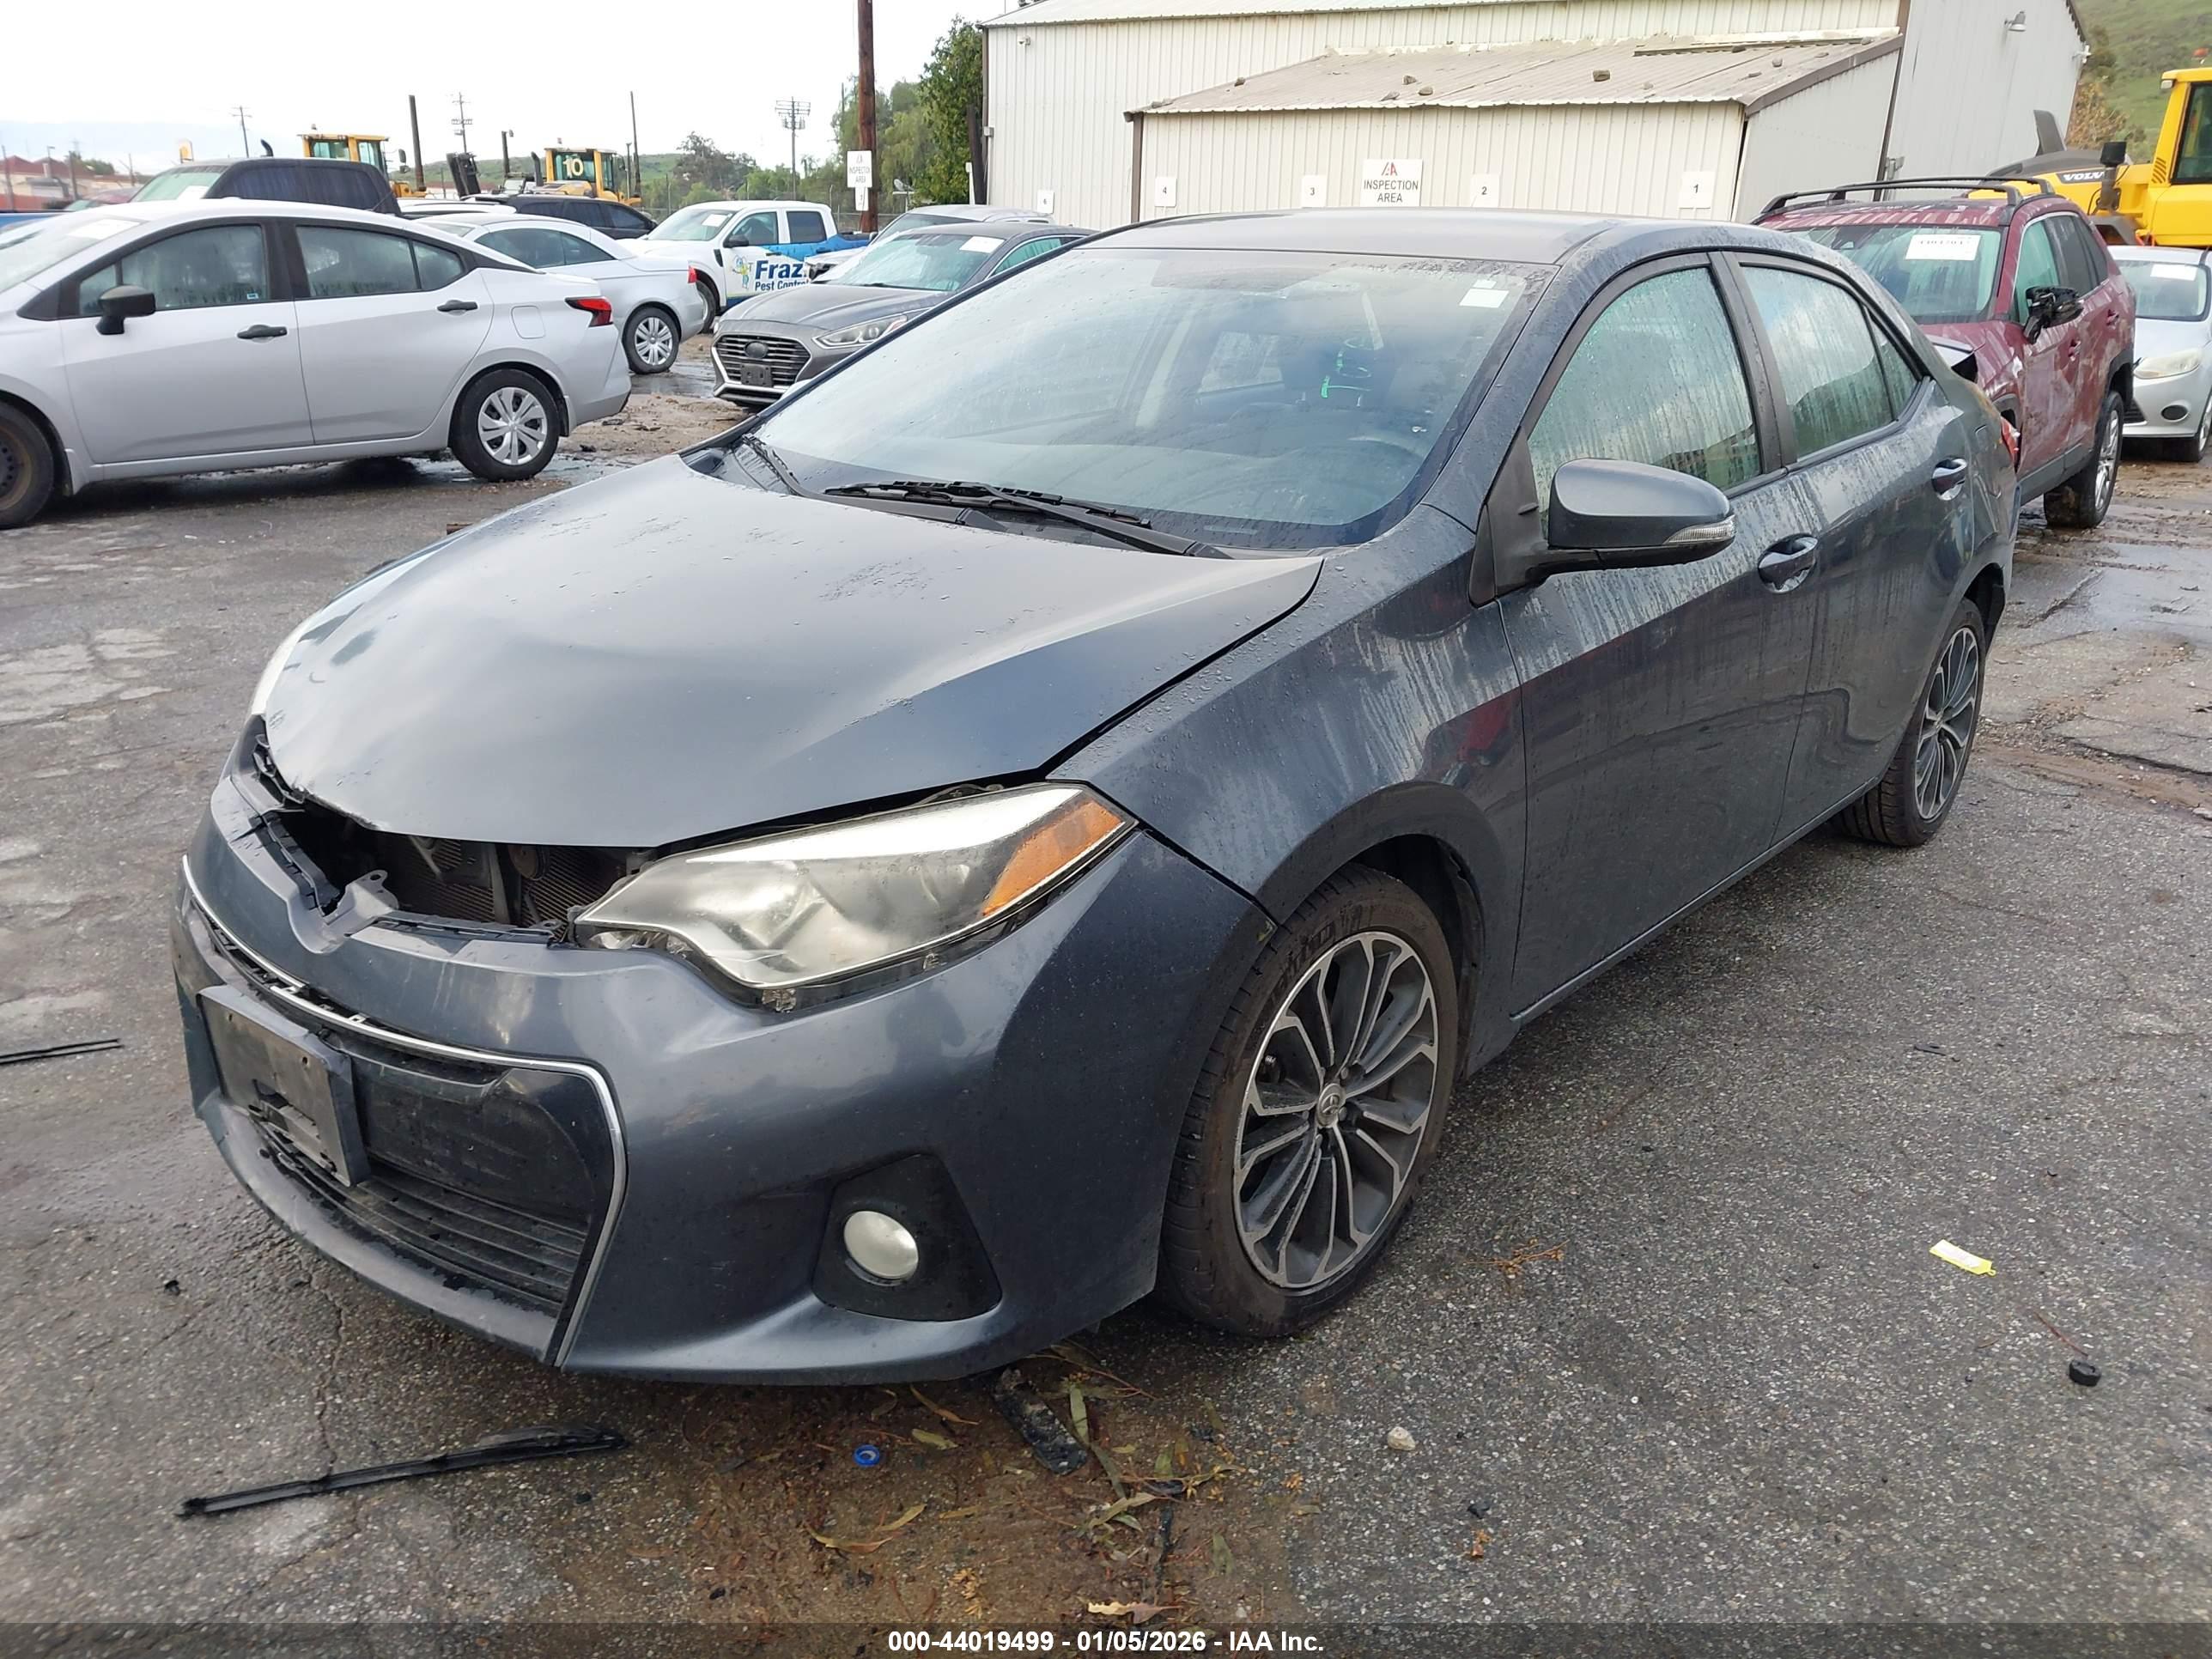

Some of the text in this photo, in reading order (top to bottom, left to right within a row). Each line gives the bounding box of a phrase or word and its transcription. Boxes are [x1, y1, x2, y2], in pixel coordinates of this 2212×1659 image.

[562, 157, 584, 178] 10
[2063, 171, 2105, 181] VOLV
[1364, 179, 1419, 191] INSPECTION
[1693, 183, 1699, 193] 1
[1162, 186, 1168, 195] 4
[1310, 187, 1316, 196] 3
[1481, 185, 1488, 196] 2
[1377, 192, 1403, 204] AREA
[756, 260, 807, 279] Fraz
[755, 281, 775, 291] Pest
